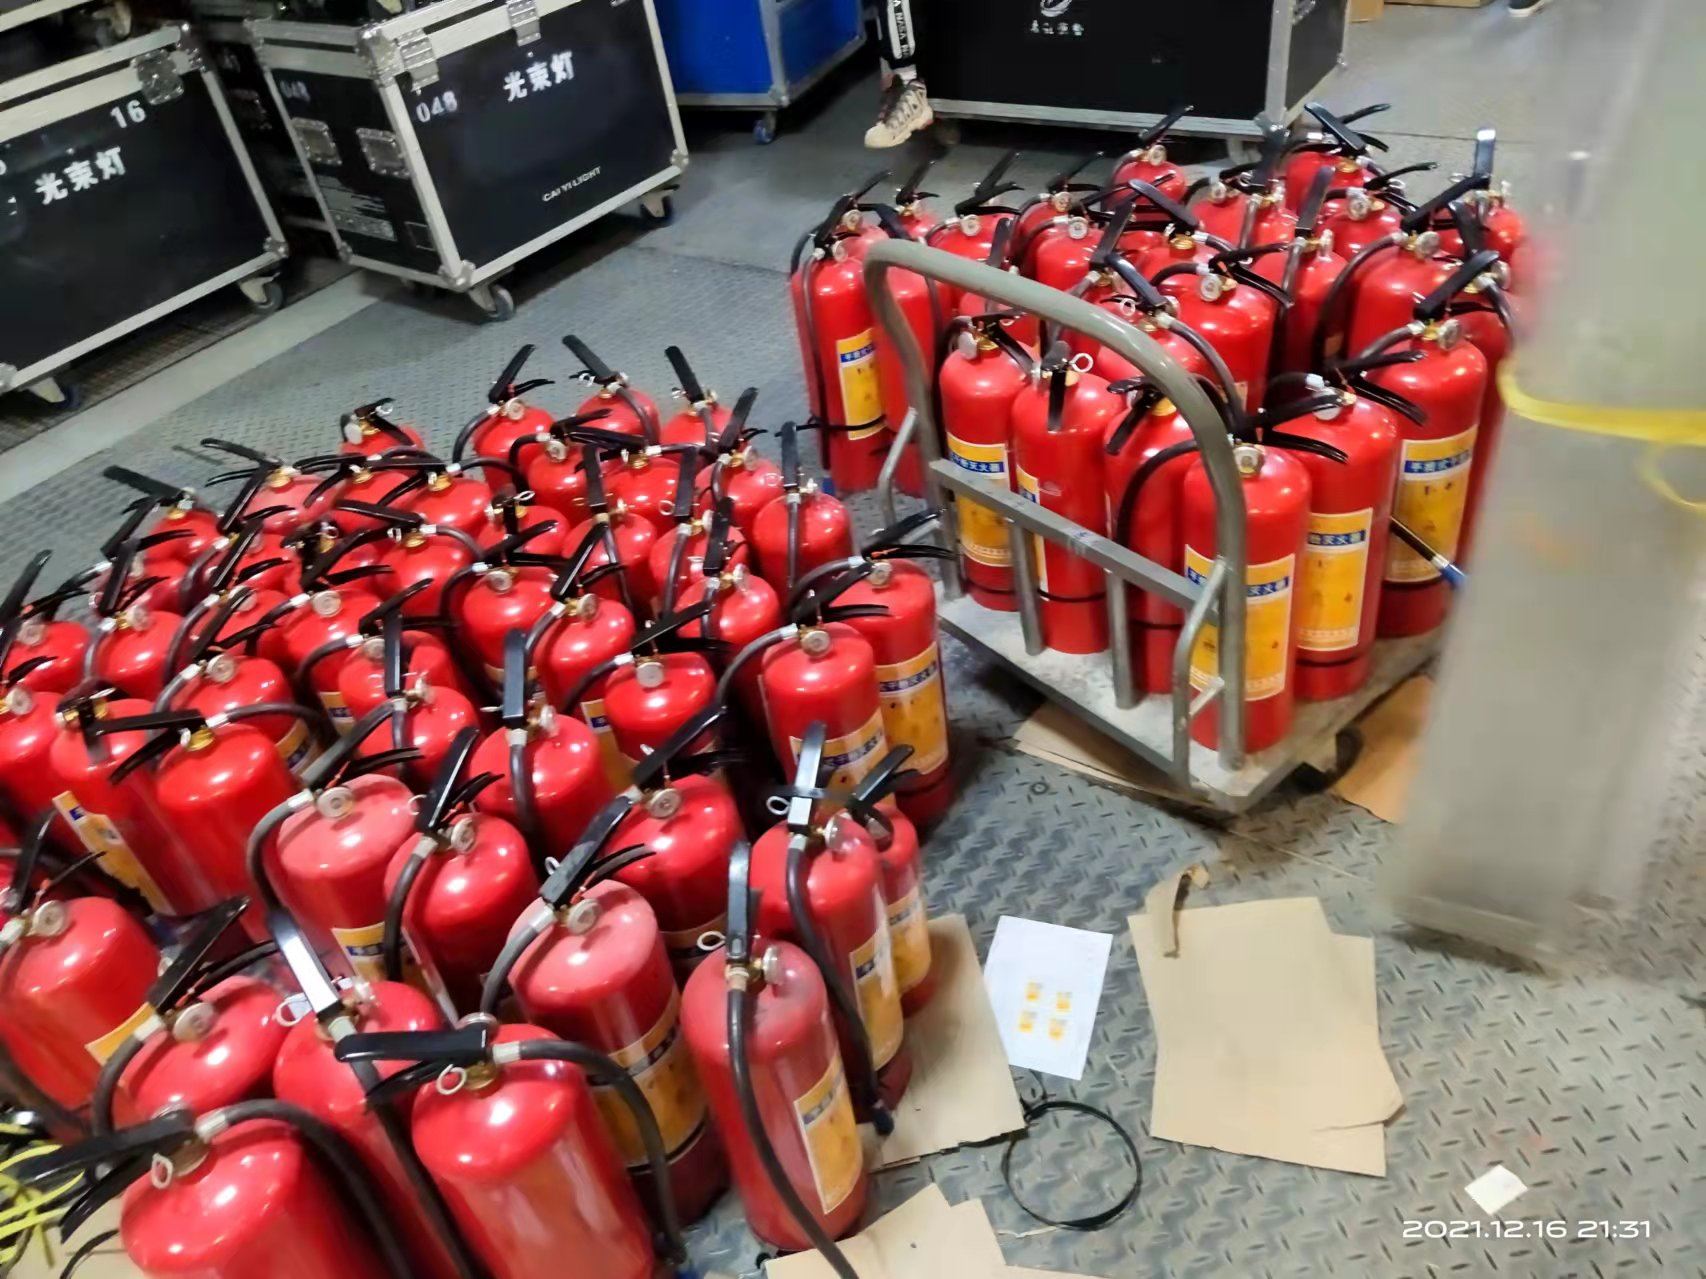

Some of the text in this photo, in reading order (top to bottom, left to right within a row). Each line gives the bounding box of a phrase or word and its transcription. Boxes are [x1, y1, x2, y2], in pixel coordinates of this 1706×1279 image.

[503, 51, 574, 102] 光束灯
[110, 100, 146, 128] 16
[416, 90, 458, 123] 048
[35, 146, 125, 205] 光束灯
